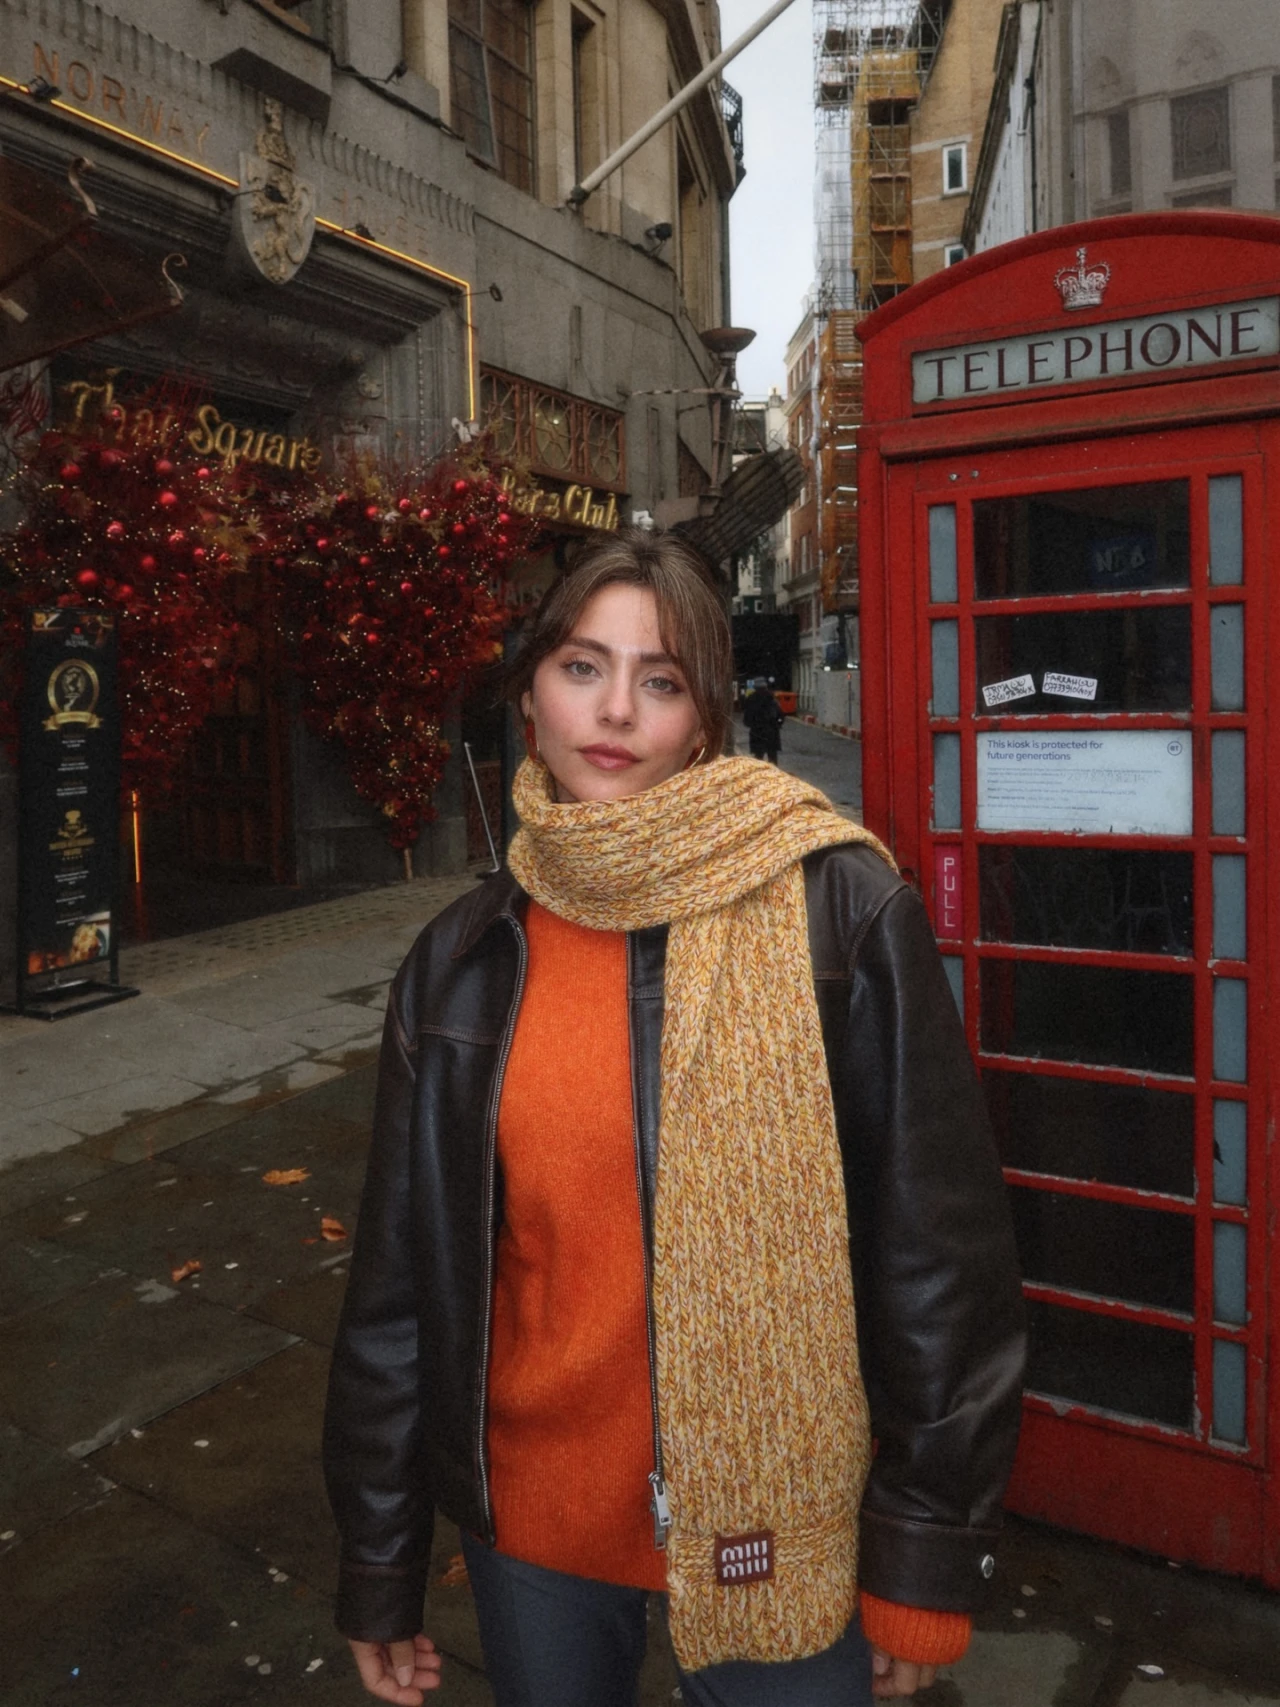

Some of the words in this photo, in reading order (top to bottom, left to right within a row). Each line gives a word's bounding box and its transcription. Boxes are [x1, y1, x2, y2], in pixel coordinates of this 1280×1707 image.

[33, 42, 211, 154] NORWAY
[924, 308, 1260, 398] TELEPHONE
[188, 404, 321, 474] Square
[987, 752, 1015, 760] future
[1016, 752, 1071, 761] generations
[988, 740, 1005, 749] This
[1007, 740, 1030, 749] kiosk
[1032, 740, 1039, 749] is
[1041, 741, 1088, 750] protected
[1089, 741, 1104, 749] for
[944, 857, 956, 927] PULL
[721, 1540, 767, 1563] miu
[722, 1558, 768, 1578] miu
